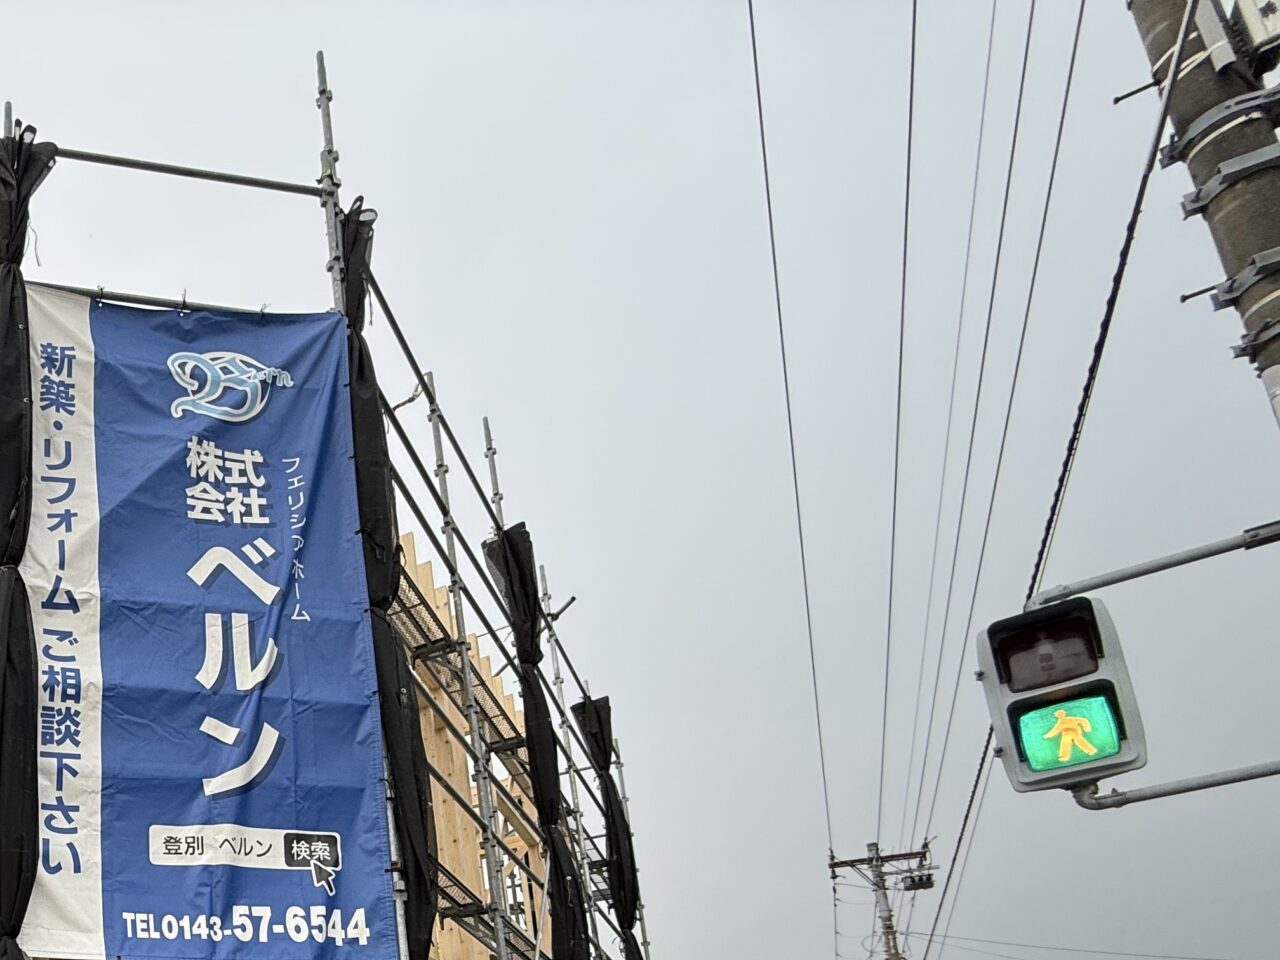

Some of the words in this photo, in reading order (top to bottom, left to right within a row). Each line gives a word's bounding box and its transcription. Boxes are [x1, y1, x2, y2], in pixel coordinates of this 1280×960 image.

[39, 342, 80, 614] 新築・リフォーム
[281, 456, 311, 622] フェリシアホーム
[39, 628, 82, 874] ご相談下さい
[186, 537, 280, 796] ベルン
[162, 835, 205, 856] 登別
[218, 836, 273, 858] ベルン
[291, 840, 332, 862] 検索
